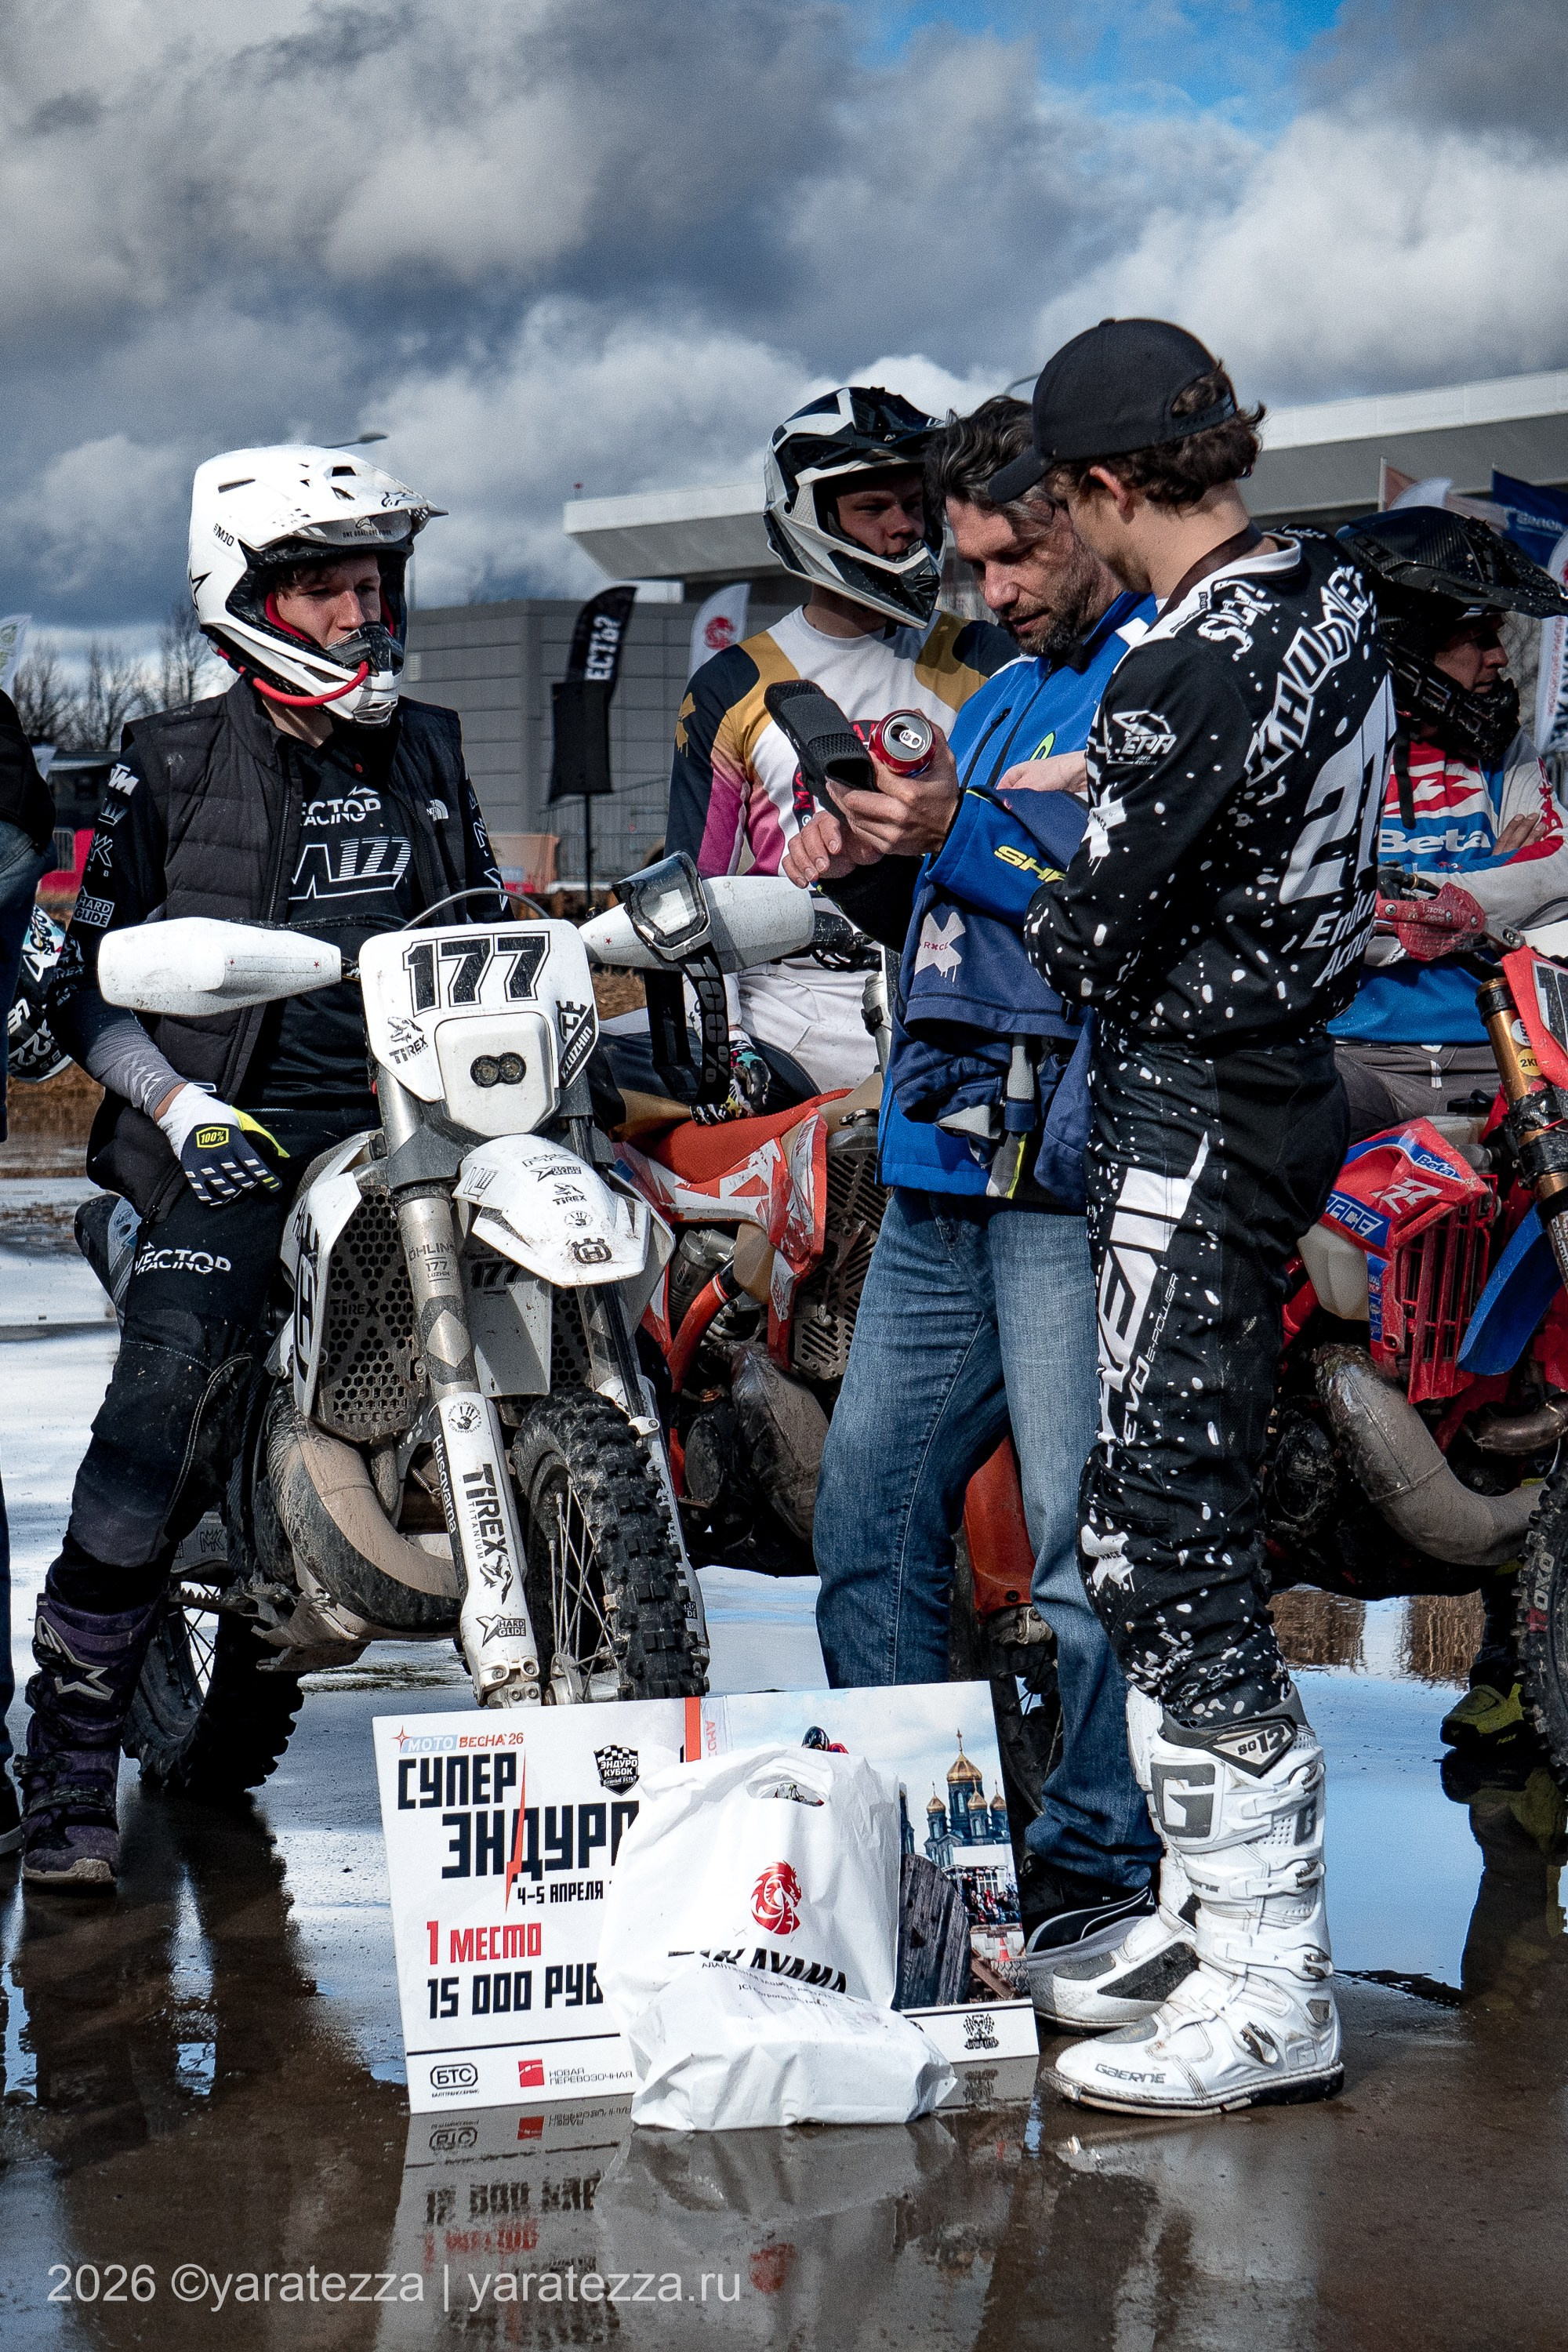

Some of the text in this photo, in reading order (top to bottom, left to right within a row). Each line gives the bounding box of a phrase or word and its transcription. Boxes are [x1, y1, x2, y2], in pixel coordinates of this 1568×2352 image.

[109, 763, 140, 796] TM
[1378, 828, 1492, 855] Beta
[403, 931, 550, 1017] 177
[684, 956, 730, 1083] 100%
[201, 1131, 224, 1145] 100%
[1415, 1154, 1456, 1178] Beta
[1327, 1192, 1384, 1237] ACE
[425, 1261, 448, 1272] 177
[471, 1259, 523, 1289] 177
[433, 1433, 458, 1535] Husqvarna
[462, 1463, 509, 1559] TIREX
[467, 1501, 485, 1560] TITANIUM
[498, 1628, 526, 1637] GLIDE
[499, 1620, 524, 1629] HARD
[407, 1735, 453, 1752] МОТО
[601, 1759, 638, 1769] ЭНДУРО
[604, 1767, 633, 1777] КУБОК
[398, 1751, 517, 1810] СУПЕР
[550, 1881, 604, 1904] АПРЕЛЯ
[427, 1920, 542, 1965] 1 МЕСТО
[427, 1962, 604, 2020] 15 000 РУБ
[436, 2067, 473, 2085] БТС
[550, 2067, 585, 2078] НОВАЯ
[550, 2071, 633, 2085] ПЕРЕВОЗОЧНАЯ
